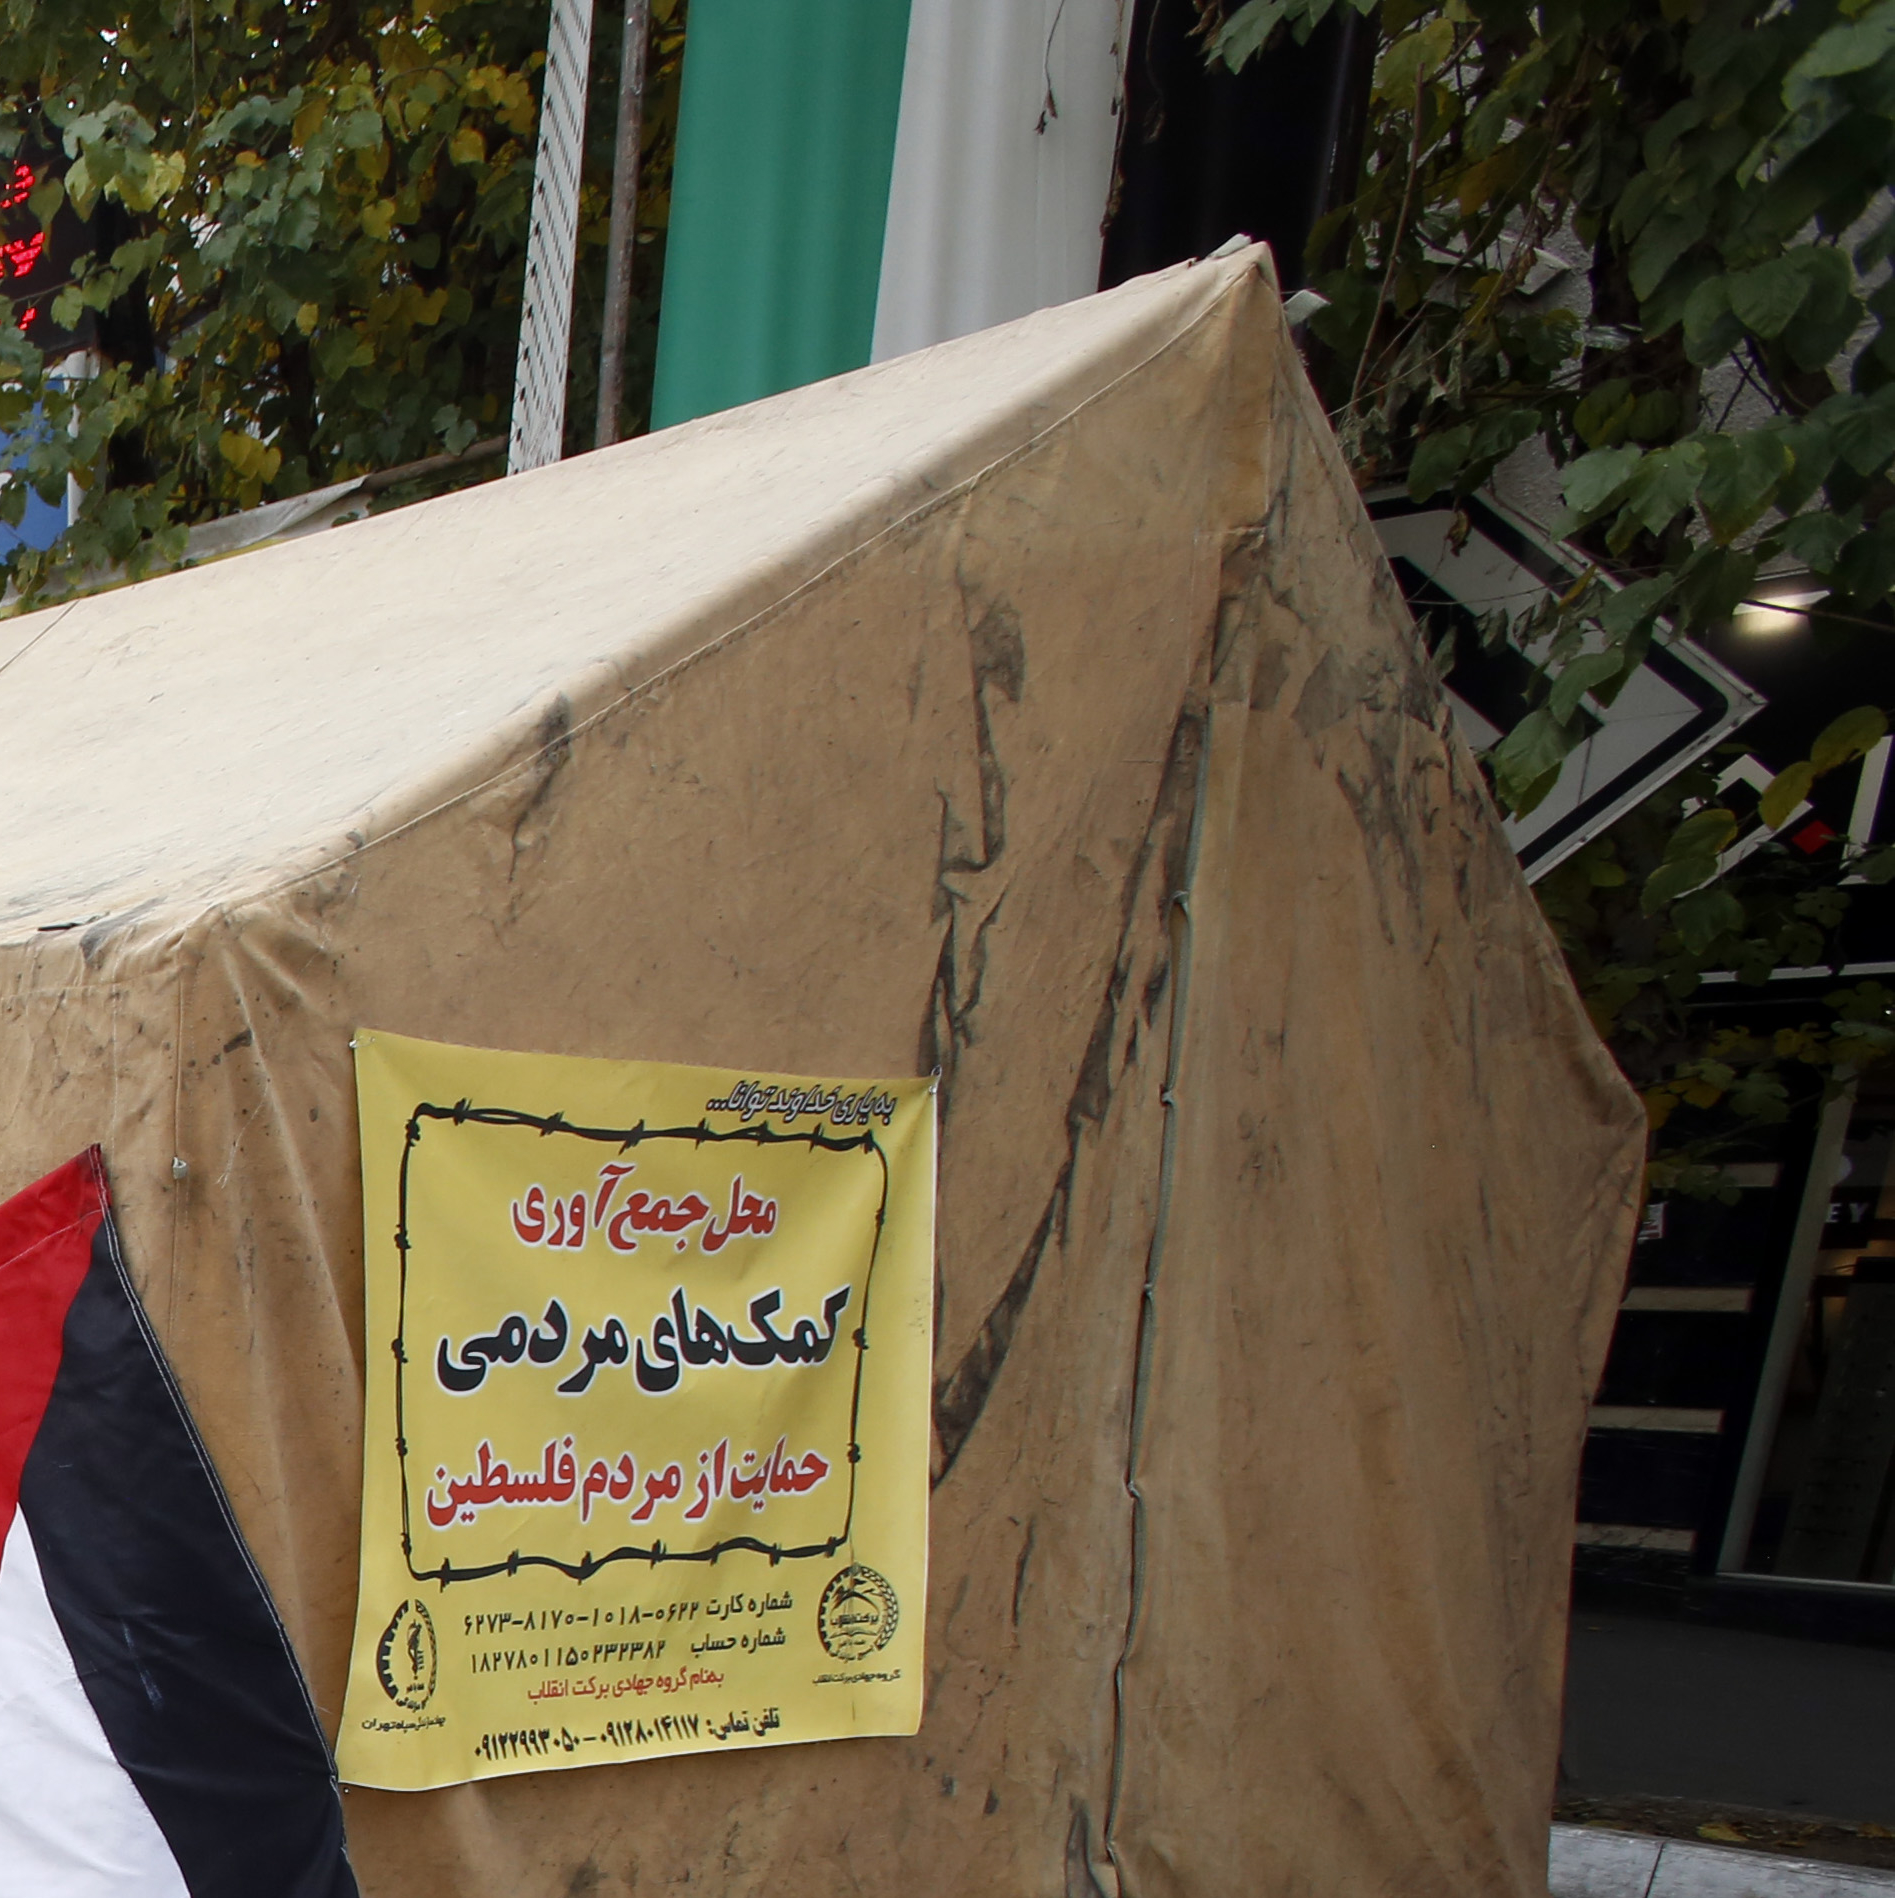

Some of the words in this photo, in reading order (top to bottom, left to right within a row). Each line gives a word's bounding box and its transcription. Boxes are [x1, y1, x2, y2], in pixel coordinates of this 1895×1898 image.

[706, 1080, 777, 1121] توانا...
[773, 1084, 844, 1123] خداوند
[831, 1086, 876, 1125] یاری
[874, 1090, 898, 1126] به
[512, 1164, 636, 1247] آوری
[608, 1190, 709, 1251] جمع
[702, 1175, 778, 1252] محل
[437, 1298, 629, 1394] مردمی
[427, 1436, 576, 1527] فلسطین
[582, 1454, 680, 1522] مردم
[684, 1439, 728, 1519] از
[730, 1436, 829, 1510] حمایت
[705, 1593, 744, 1621] کارت
[747, 1590, 793, 1616] شماره
[690, 1633, 736, 1655] حساب
[740, 1627, 786, 1654] شماره
[527, 1680, 569, 1705] انقلاب
[572, 1677, 609, 1699] برکت
[613, 1674, 654, 1697] جهادی
[656, 1666, 688, 1693] گروه
[705, 1710, 749, 1741] تماس:
[752, 1707, 780, 1736] تلفن
